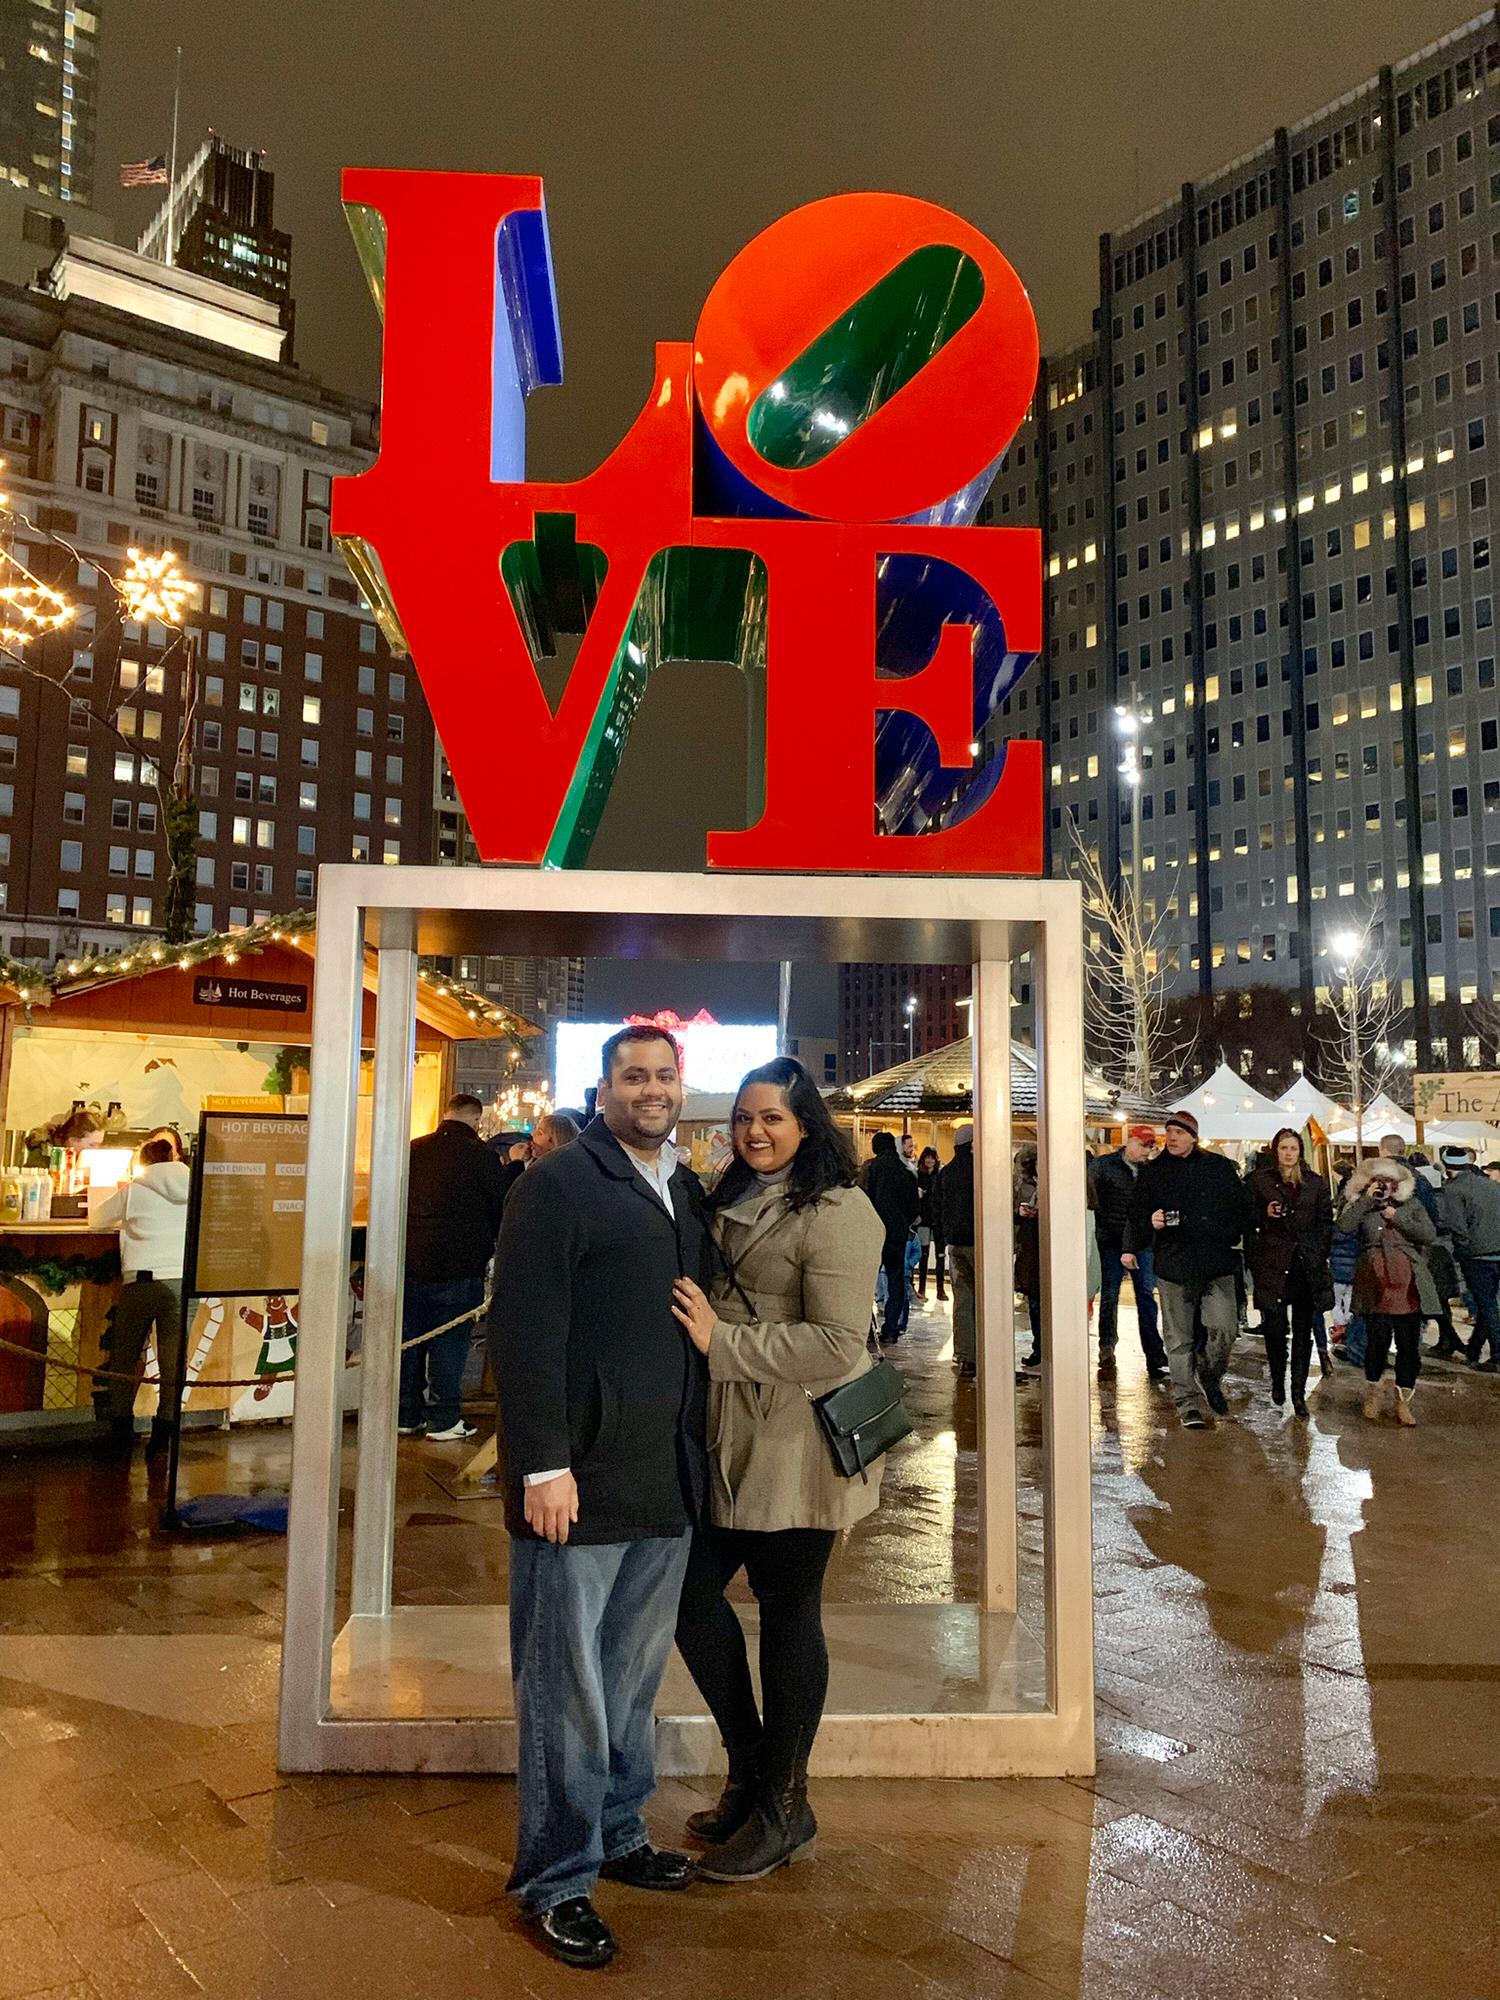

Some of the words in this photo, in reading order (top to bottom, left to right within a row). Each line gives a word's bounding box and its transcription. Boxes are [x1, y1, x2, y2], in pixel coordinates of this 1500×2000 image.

[228, 987, 247, 999] Hot
[251, 989, 302, 1005] Beverages
[1437, 1091, 1483, 1113] The
[221, 1121, 249, 1133] HOT
[212, 1165, 229, 1174] HOT
[232, 1165, 263, 1174] DRINKS
[280, 1166, 303, 1174] COLD
[278, 1202, 304, 1210] SNAC
